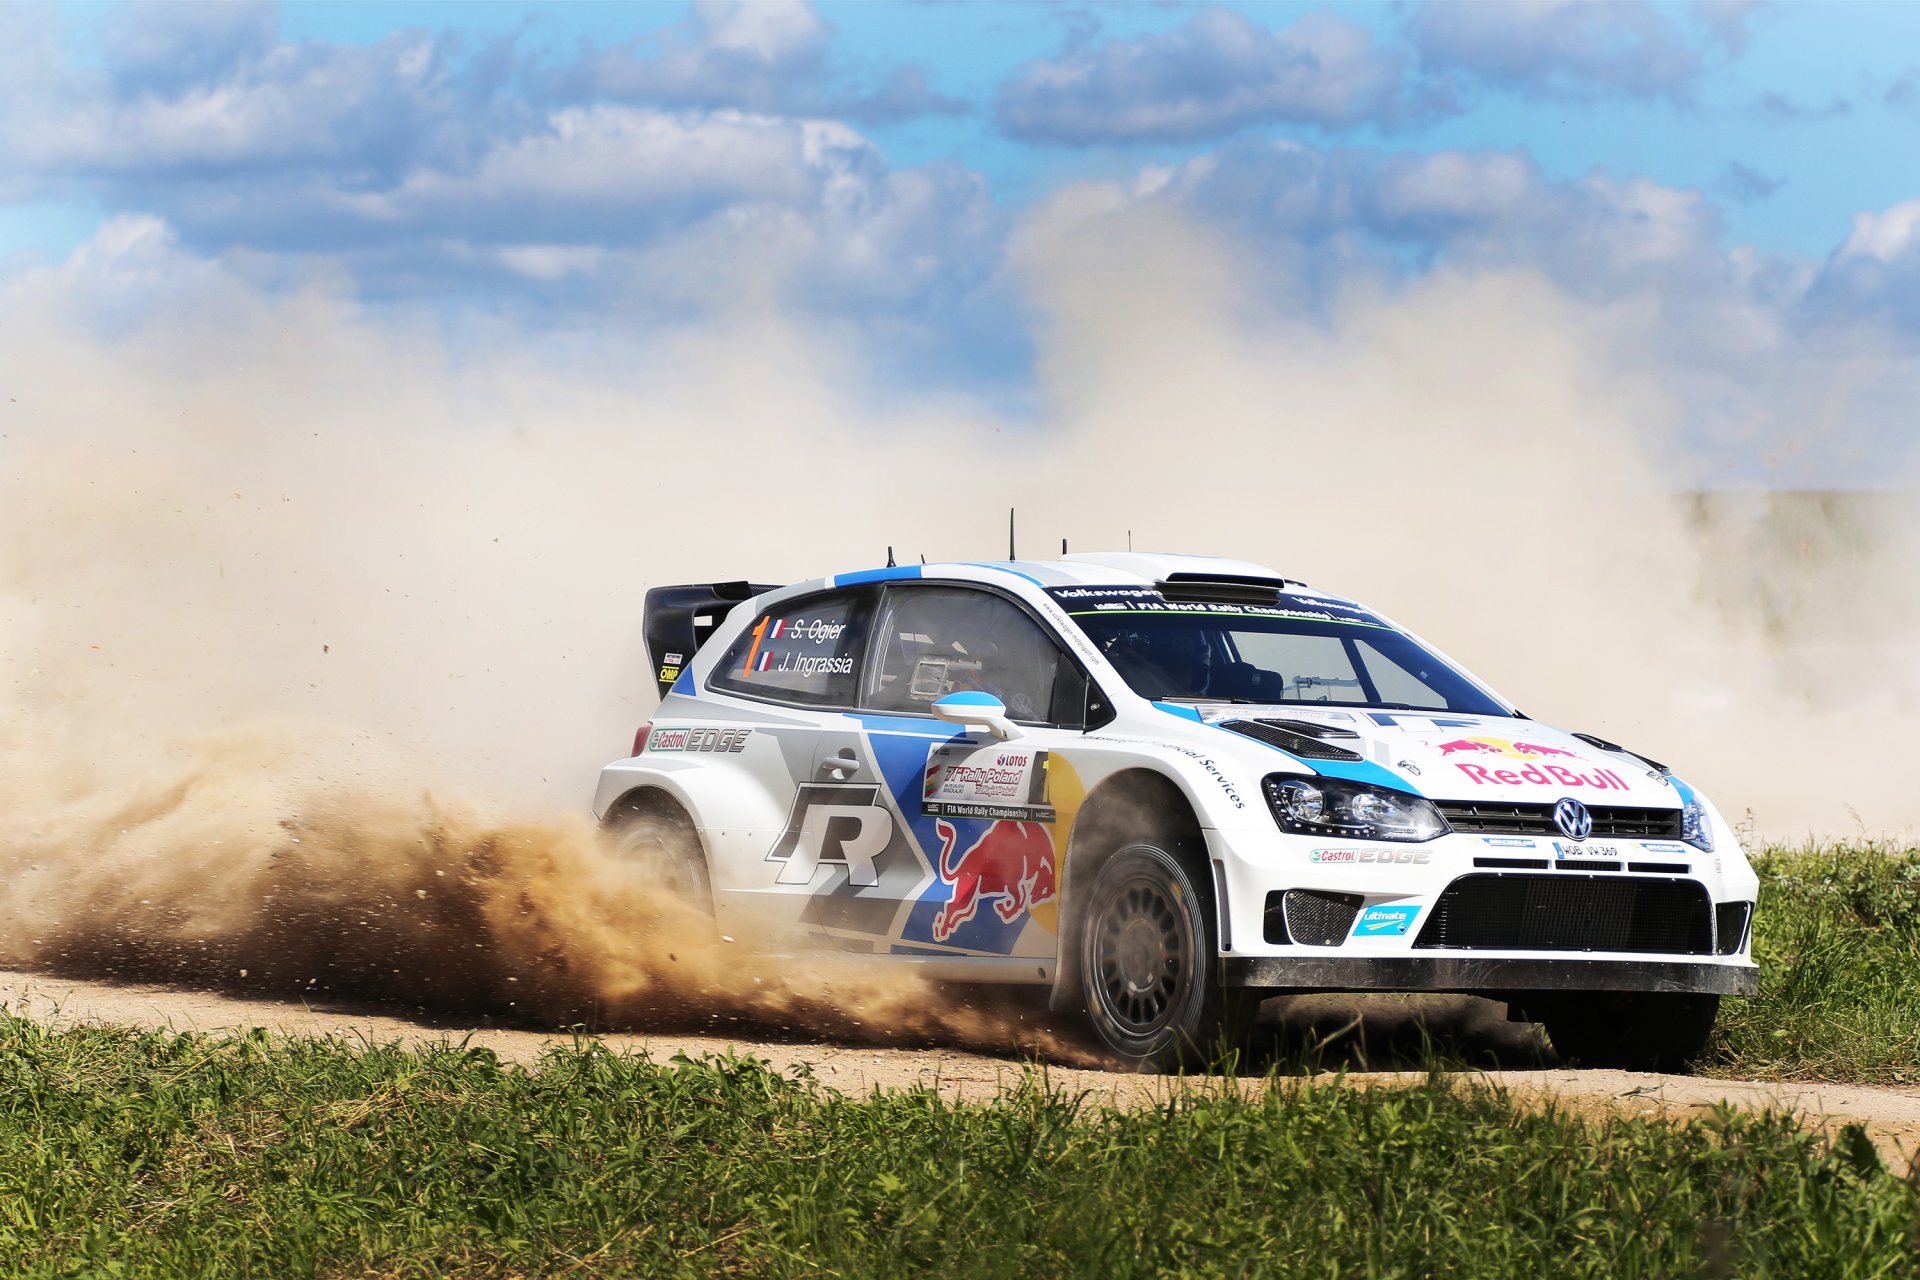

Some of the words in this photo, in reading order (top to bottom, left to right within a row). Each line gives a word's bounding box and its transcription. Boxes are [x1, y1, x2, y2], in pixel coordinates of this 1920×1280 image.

[1054, 588, 1163, 598] Volkswagen
[1164, 602, 1207, 612] World
[1207, 604, 1243, 614] Rally
[790, 619, 803, 639] S.
[808, 619, 846, 644] Ogier
[742, 615, 771, 678] 1
[778, 651, 789, 672] J.
[793, 651, 853, 677] Ingrassia
[660, 668, 679, 680] OMP
[658, 731, 687, 749] Castrol
[685, 728, 752, 752] EDGE
[1006, 755, 1028, 767] LOTOS
[960, 767, 988, 785] Rally
[985, 768, 1023, 784] Poland
[1198, 758, 1246, 810] Services
[947, 804, 957, 814] FIA
[957, 805, 974, 815] World
[974, 806, 988, 817] Rally
[989, 807, 1027, 820] Championship
[1321, 850, 1355, 861] Castrol
[1358, 848, 1433, 865] EDGE
[1562, 845, 1583, 855] WOB
[1599, 846, 1618, 857] 369
[1363, 911, 1407, 920] ultimate
